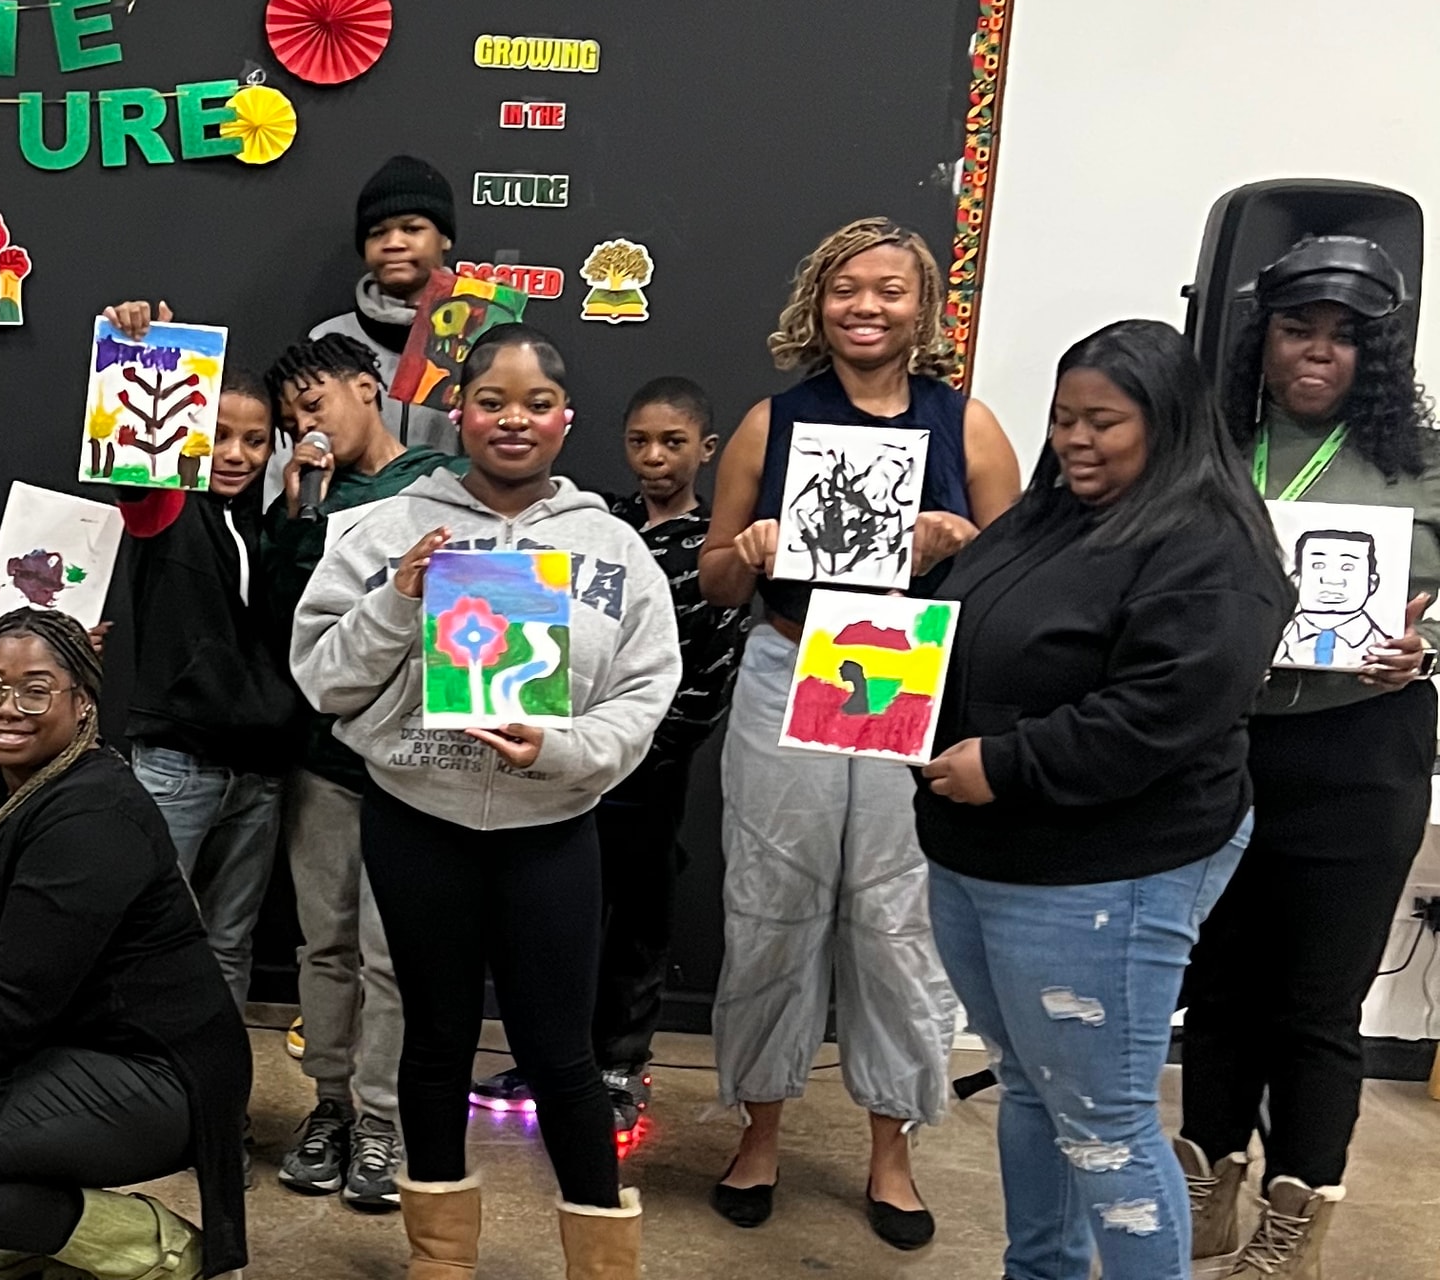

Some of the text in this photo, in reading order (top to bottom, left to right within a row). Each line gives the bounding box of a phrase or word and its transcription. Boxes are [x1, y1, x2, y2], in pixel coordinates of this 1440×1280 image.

[475, 35, 599, 71] GROWING
[502, 104, 564, 127] IN THE
[475, 174, 568, 205] FUTURE
[413, 741, 435, 754] BY
[389, 753, 417, 767] ALL
